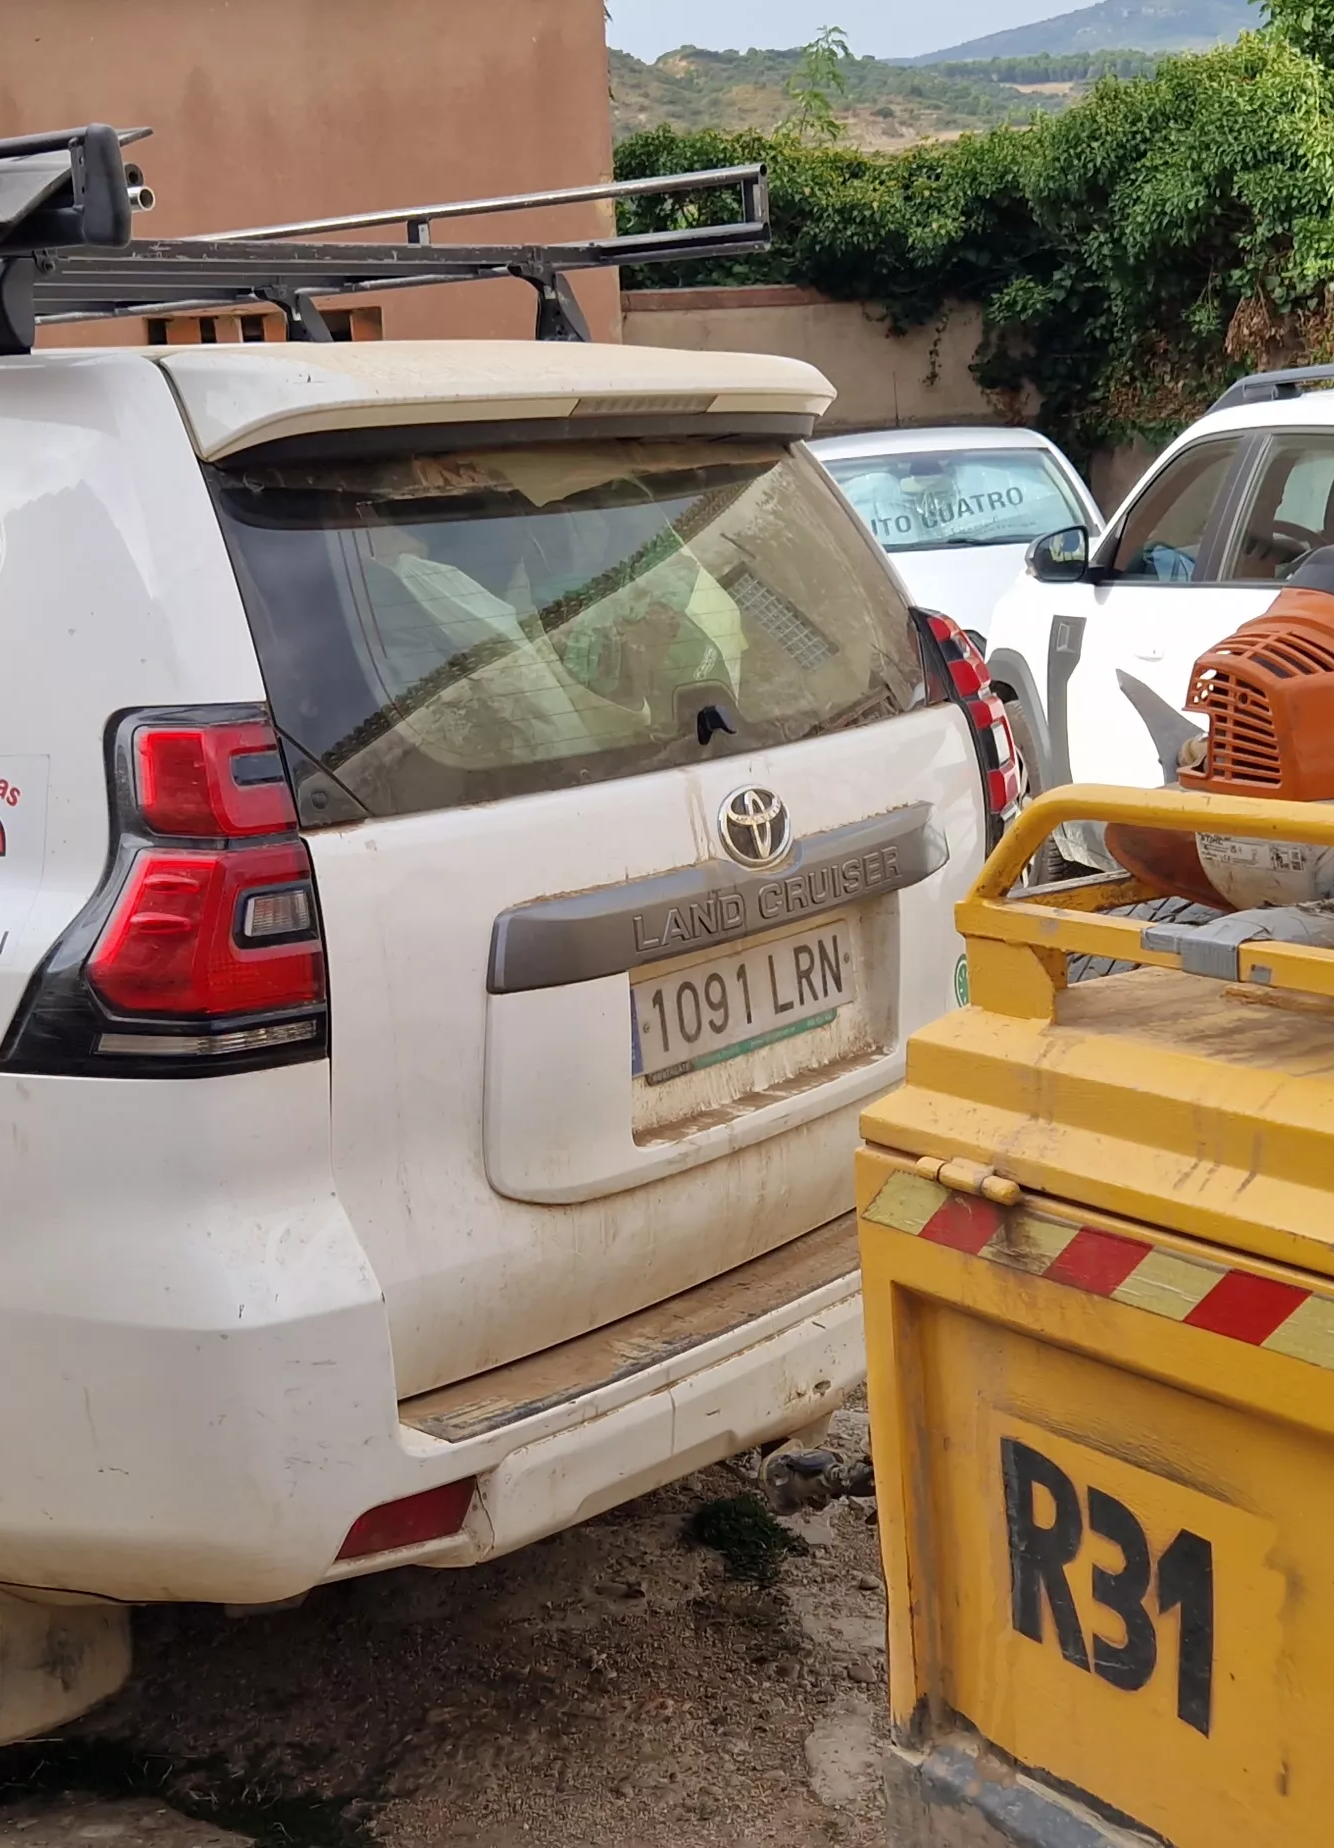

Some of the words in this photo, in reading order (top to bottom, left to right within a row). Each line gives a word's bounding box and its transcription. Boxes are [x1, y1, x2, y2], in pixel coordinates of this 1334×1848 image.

[921, 487, 1024, 528] CUATRO
[633, 891, 746, 952] LAND
[758, 846, 903, 919] CRUISER
[651, 963, 752, 1052] 1091
[767, 934, 843, 1015] LRN
[1000, 1435, 1214, 1739] R31
